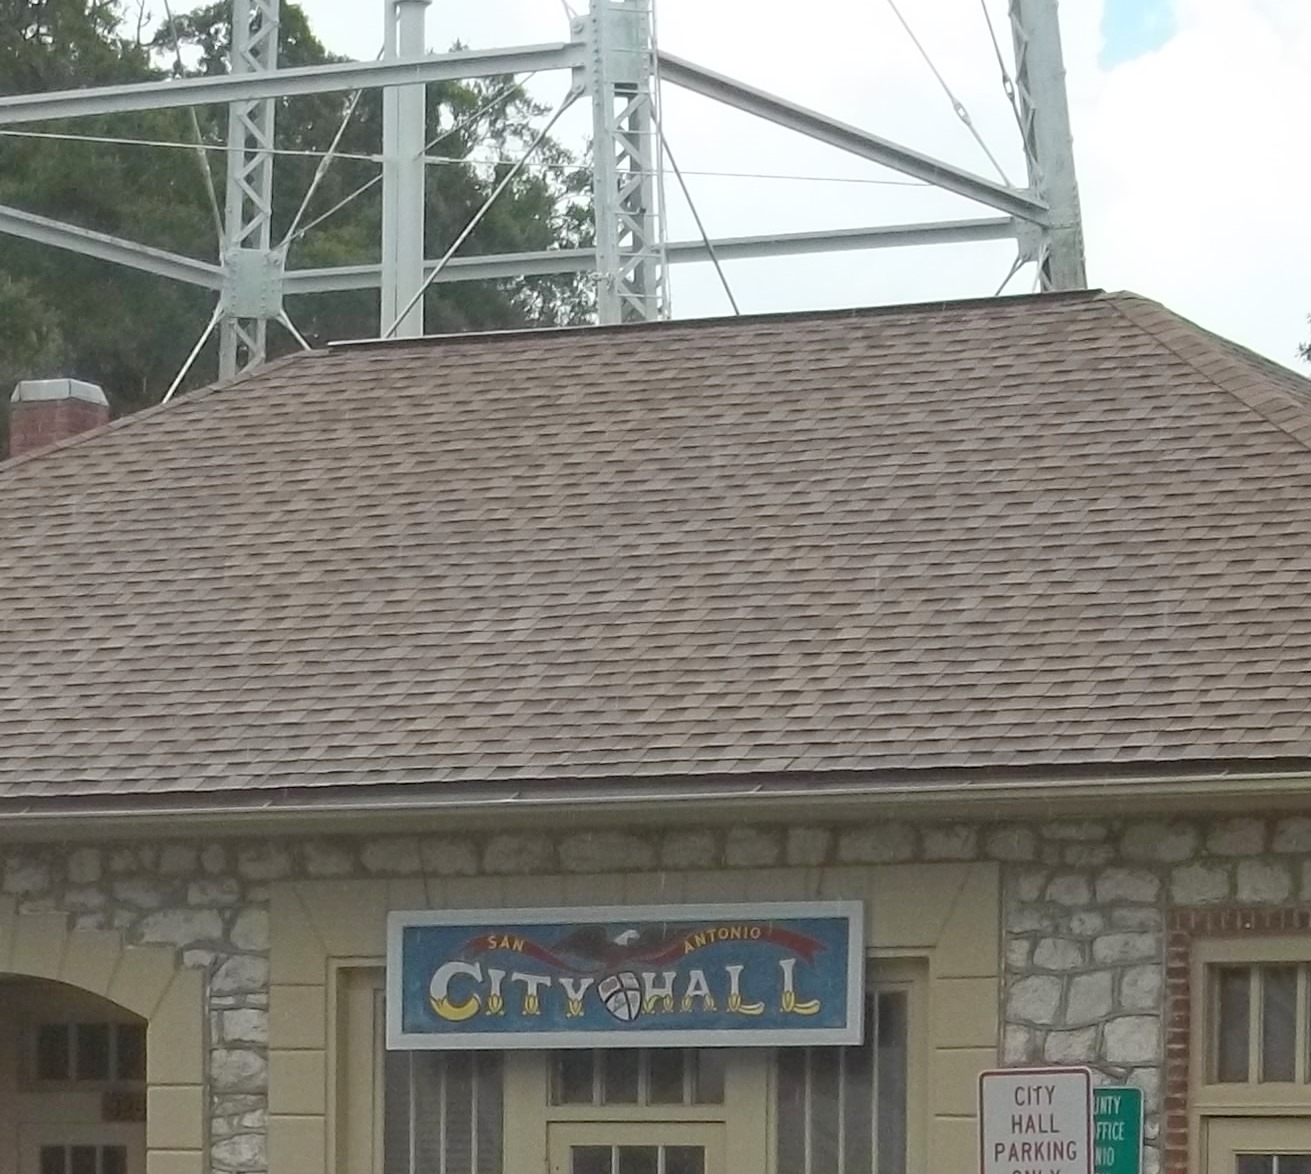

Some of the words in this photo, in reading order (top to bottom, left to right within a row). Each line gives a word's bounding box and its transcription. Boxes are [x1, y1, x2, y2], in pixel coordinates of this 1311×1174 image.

[488, 934, 524, 951] SAN
[684, 926, 761, 955] ANTONIO
[430, 961, 594, 1021] CITY
[641, 958, 821, 1015] HALL
[1014, 1085, 1056, 1106] CITY
[1011, 1114, 1060, 1134] HALL
[994, 1140, 1077, 1162] PARKING
